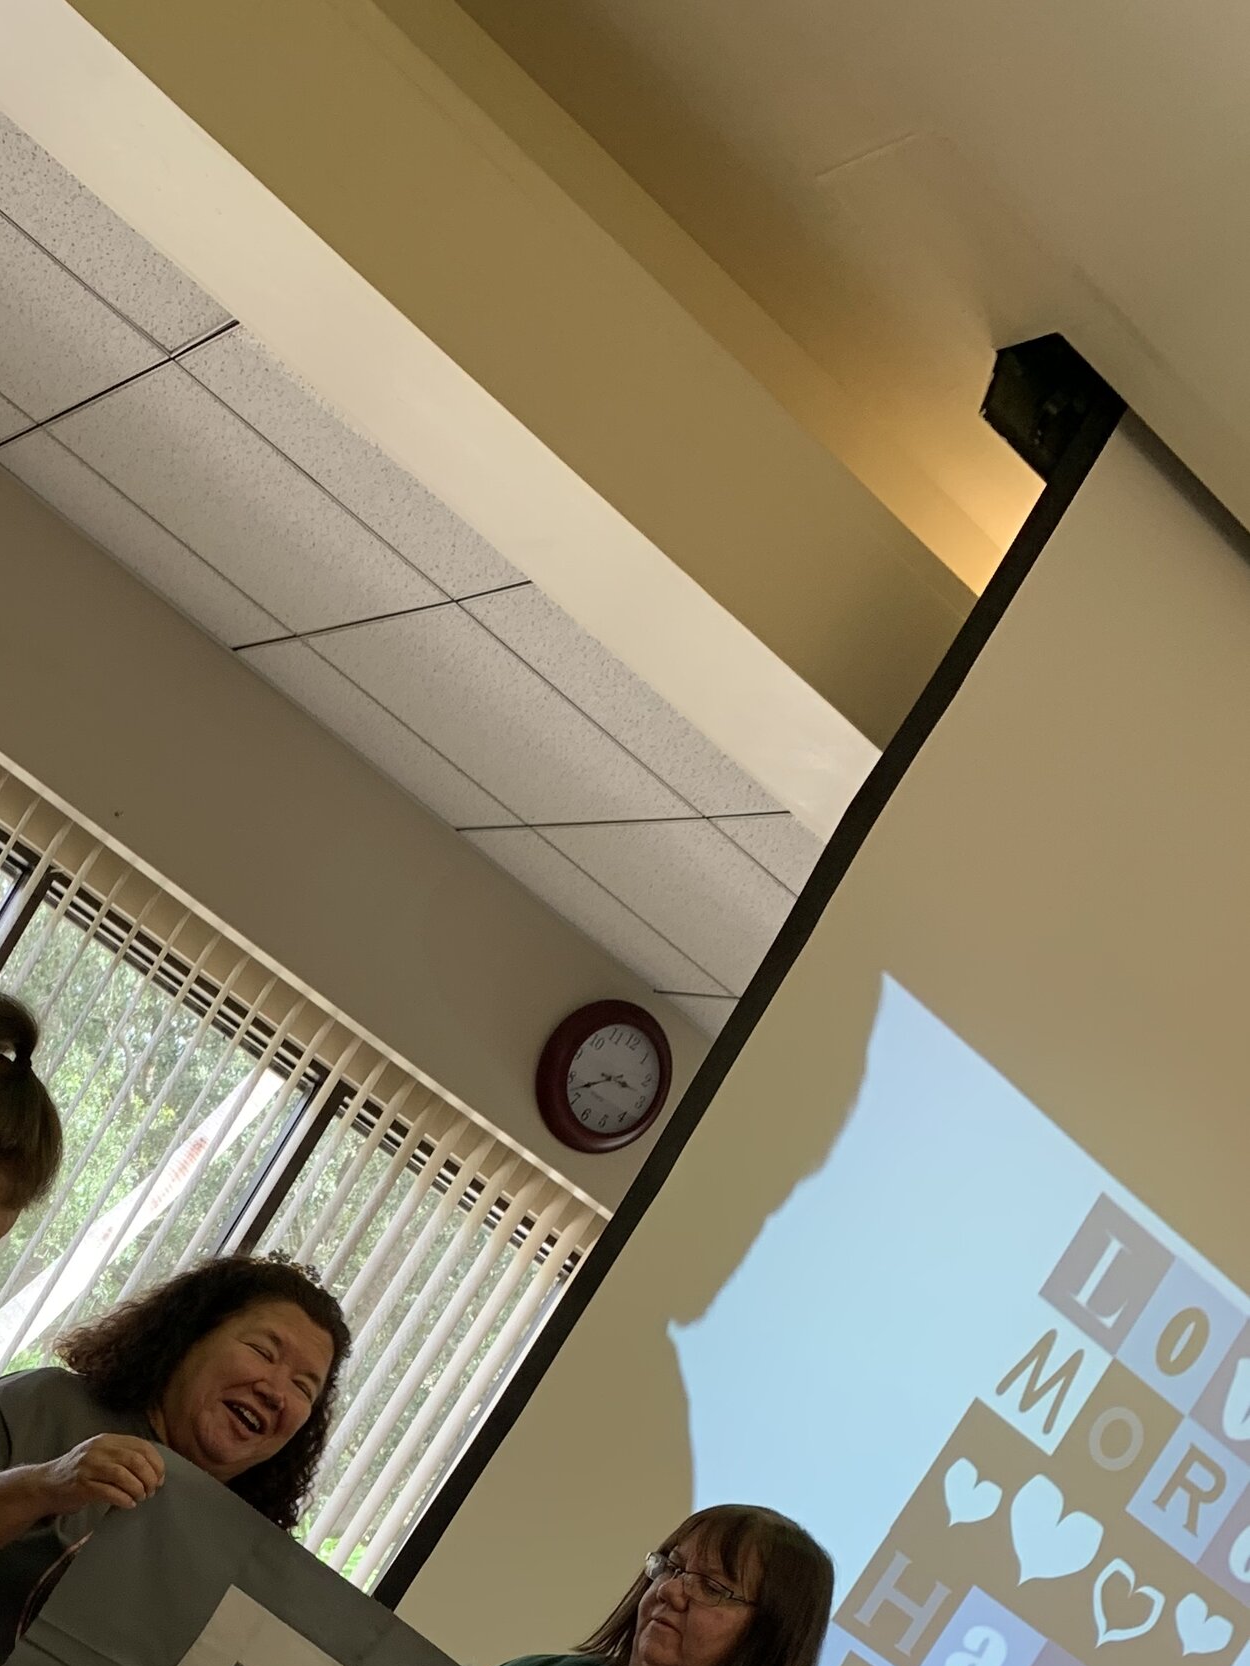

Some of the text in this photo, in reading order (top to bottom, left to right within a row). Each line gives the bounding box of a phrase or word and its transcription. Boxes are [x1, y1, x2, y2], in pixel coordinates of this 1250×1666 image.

[590, 1034, 605, 1050] 10
[609, 1028, 623, 1045] 11
[625, 1034, 641, 1051] 12
[639, 1052, 649, 1065] 1
[640, 1073, 652, 1087] 2
[570, 1092, 581, 1106] 7
[635, 1095, 646, 1109] 3
[580, 1108, 591, 1121] 6
[598, 1114, 609, 1128] 5
[617, 1110, 628, 1123] 4
